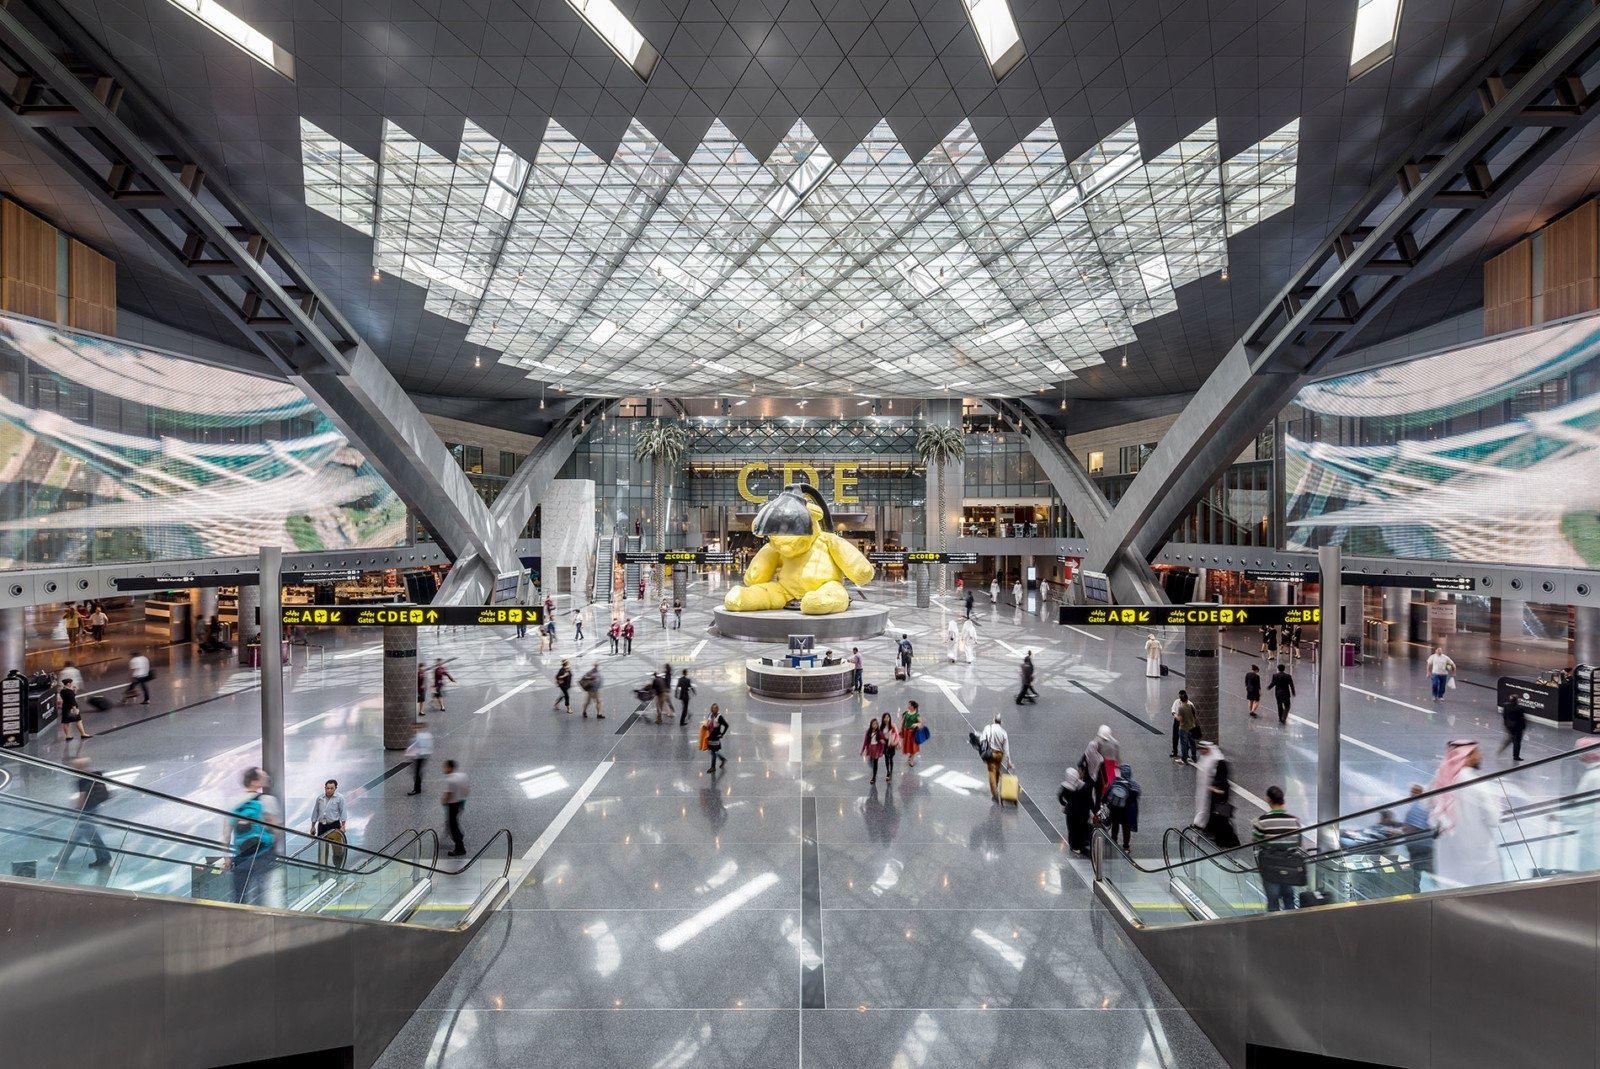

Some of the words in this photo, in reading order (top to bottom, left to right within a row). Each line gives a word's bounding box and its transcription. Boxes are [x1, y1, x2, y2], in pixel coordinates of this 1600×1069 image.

[302, 610, 312, 622] A
[377, 610, 408, 622] CDE
[498, 610, 507, 622] B
[1108, 610, 1119, 622] A
[1187, 610, 1218, 622] CDE
[1303, 610, 1312, 622] B
